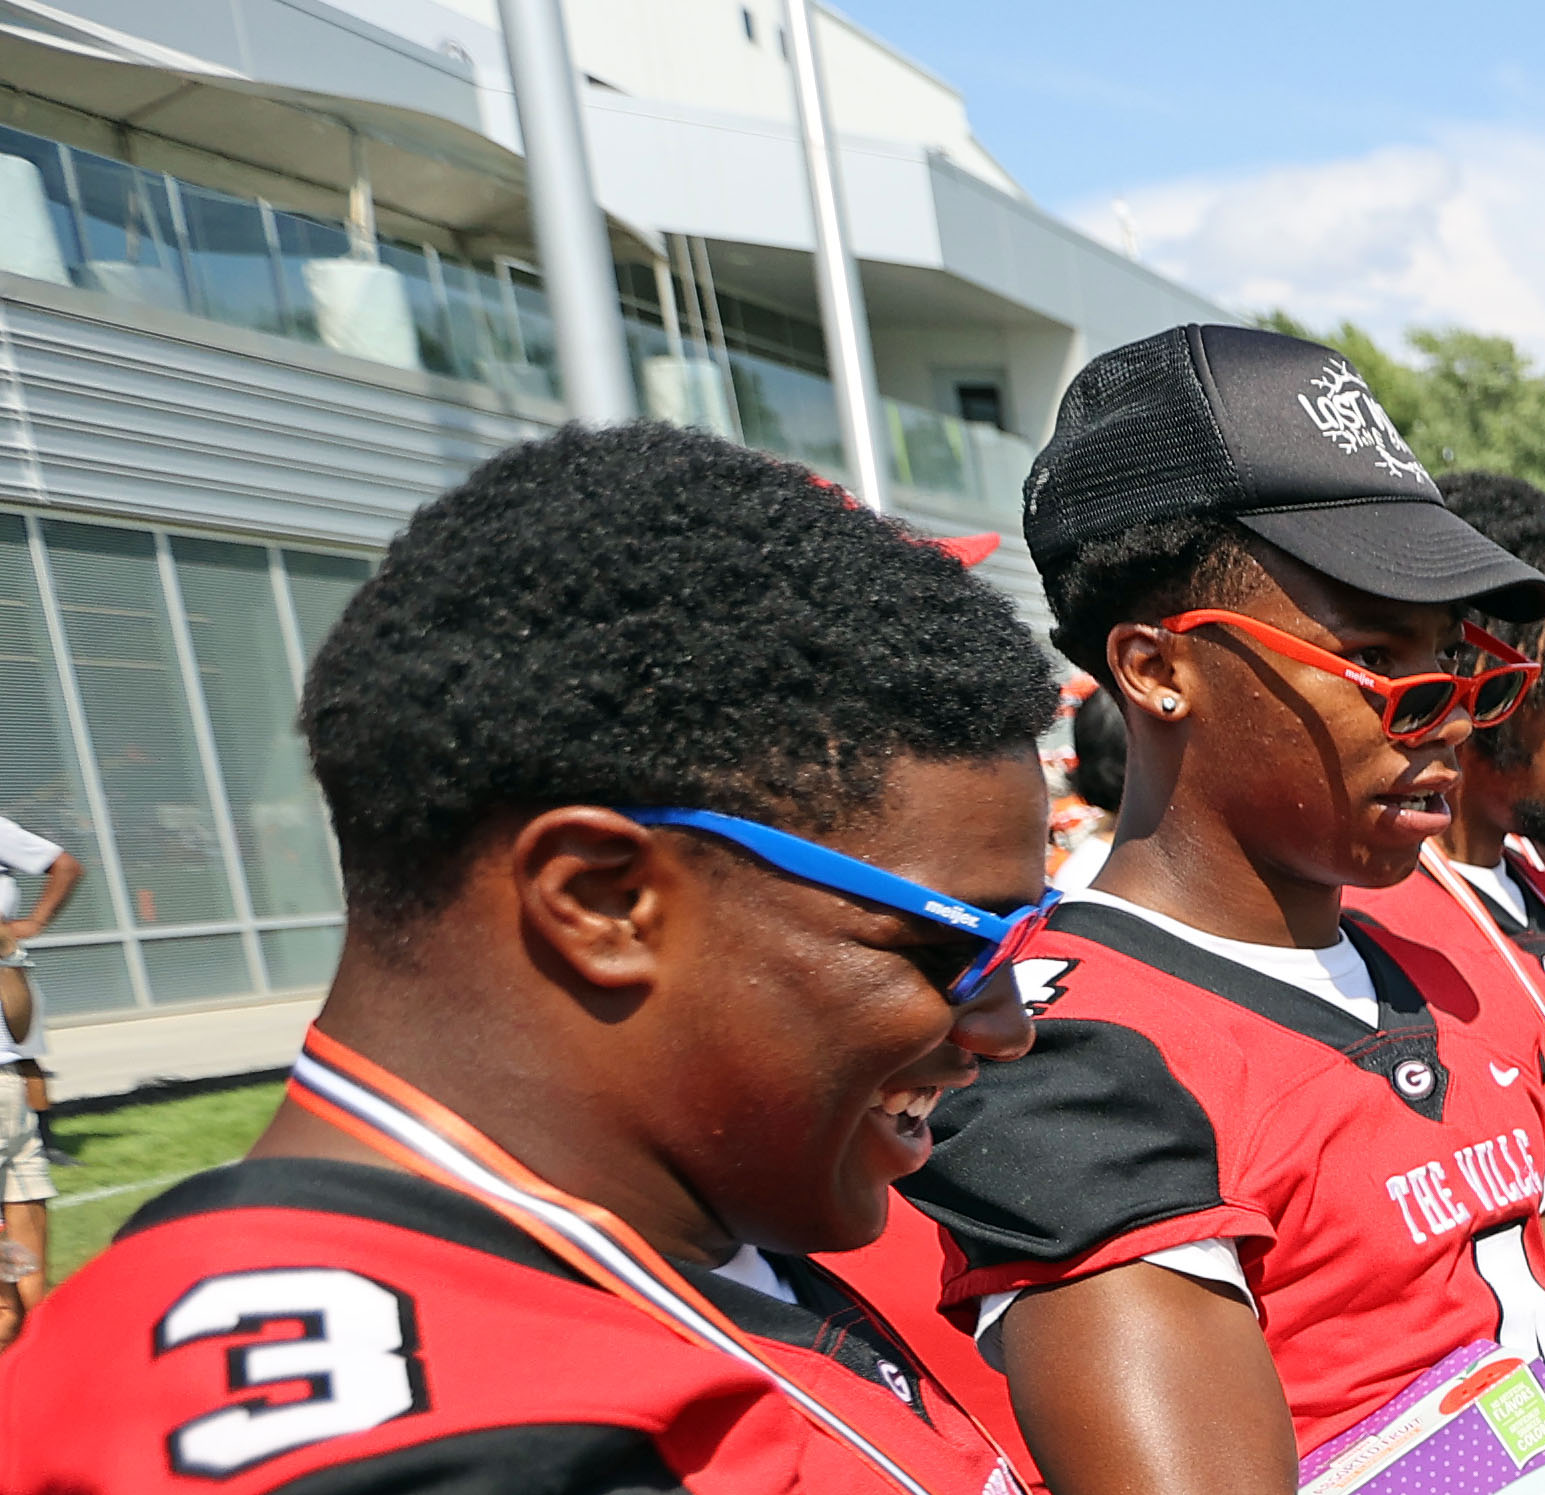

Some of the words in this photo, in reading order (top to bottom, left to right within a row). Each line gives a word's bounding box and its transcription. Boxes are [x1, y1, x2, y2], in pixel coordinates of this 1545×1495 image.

[1297, 390, 1367, 431] LOST
[1386, 1161, 1471, 1245] THE
[1454, 1128, 1543, 1212] VILLE
[152, 1267, 431, 1482] 3
